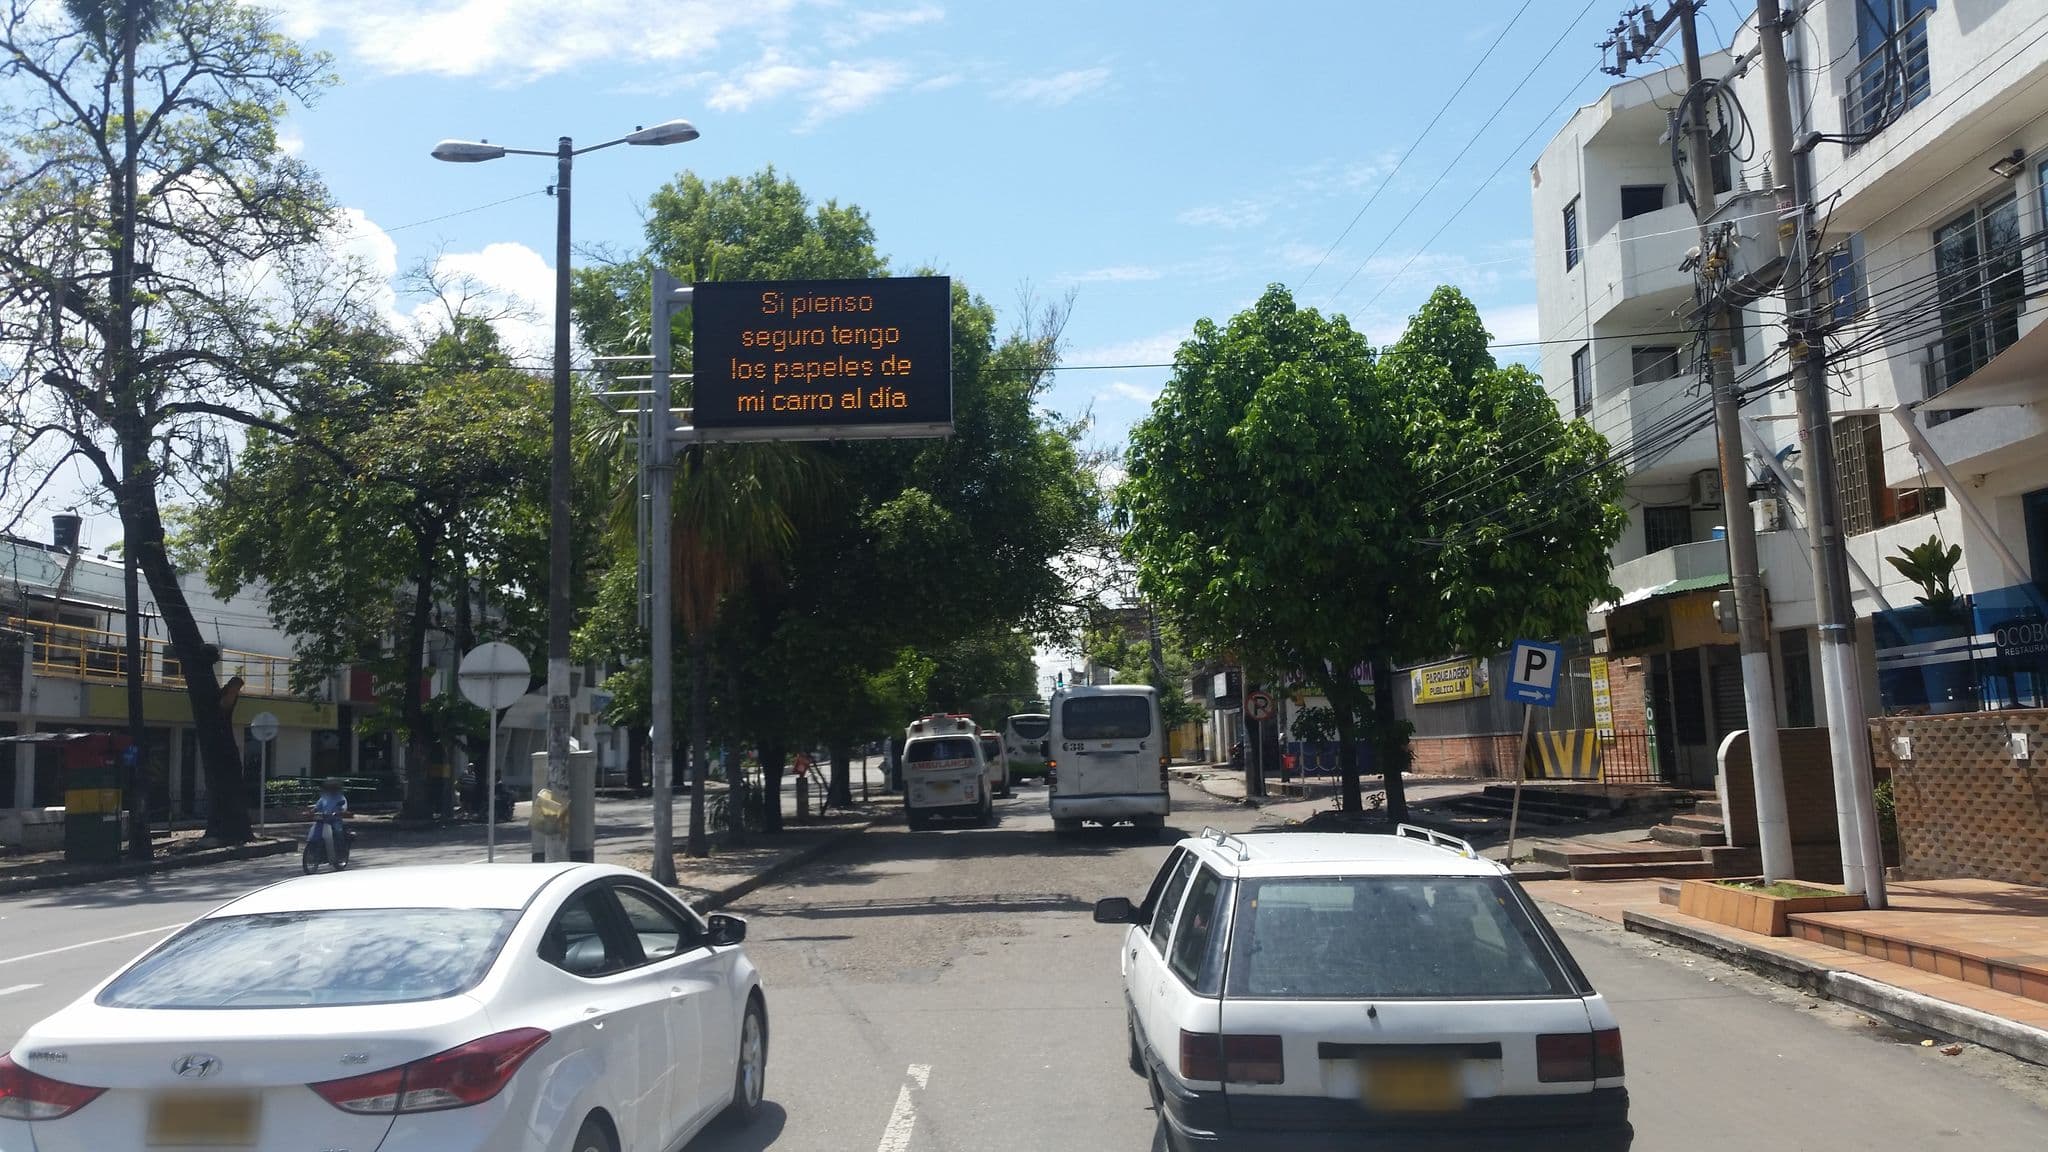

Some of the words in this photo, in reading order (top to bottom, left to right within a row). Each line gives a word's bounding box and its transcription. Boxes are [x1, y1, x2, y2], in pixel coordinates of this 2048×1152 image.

[761, 292, 784, 314] Si
[791, 291, 873, 319] pienso
[742, 328, 825, 352] seguro
[831, 325, 900, 349] tengo
[730, 358, 766, 379] los
[773, 355, 873, 384] papeles
[881, 354, 912, 376] de
[736, 390, 765, 412] mi
[772, 392, 833, 411] carro
[840, 387, 862, 409] al
[869, 386, 909, 409] día
[1425, 666, 1470, 684] PARQUEADERO
[1523, 649, 1548, 682] P
